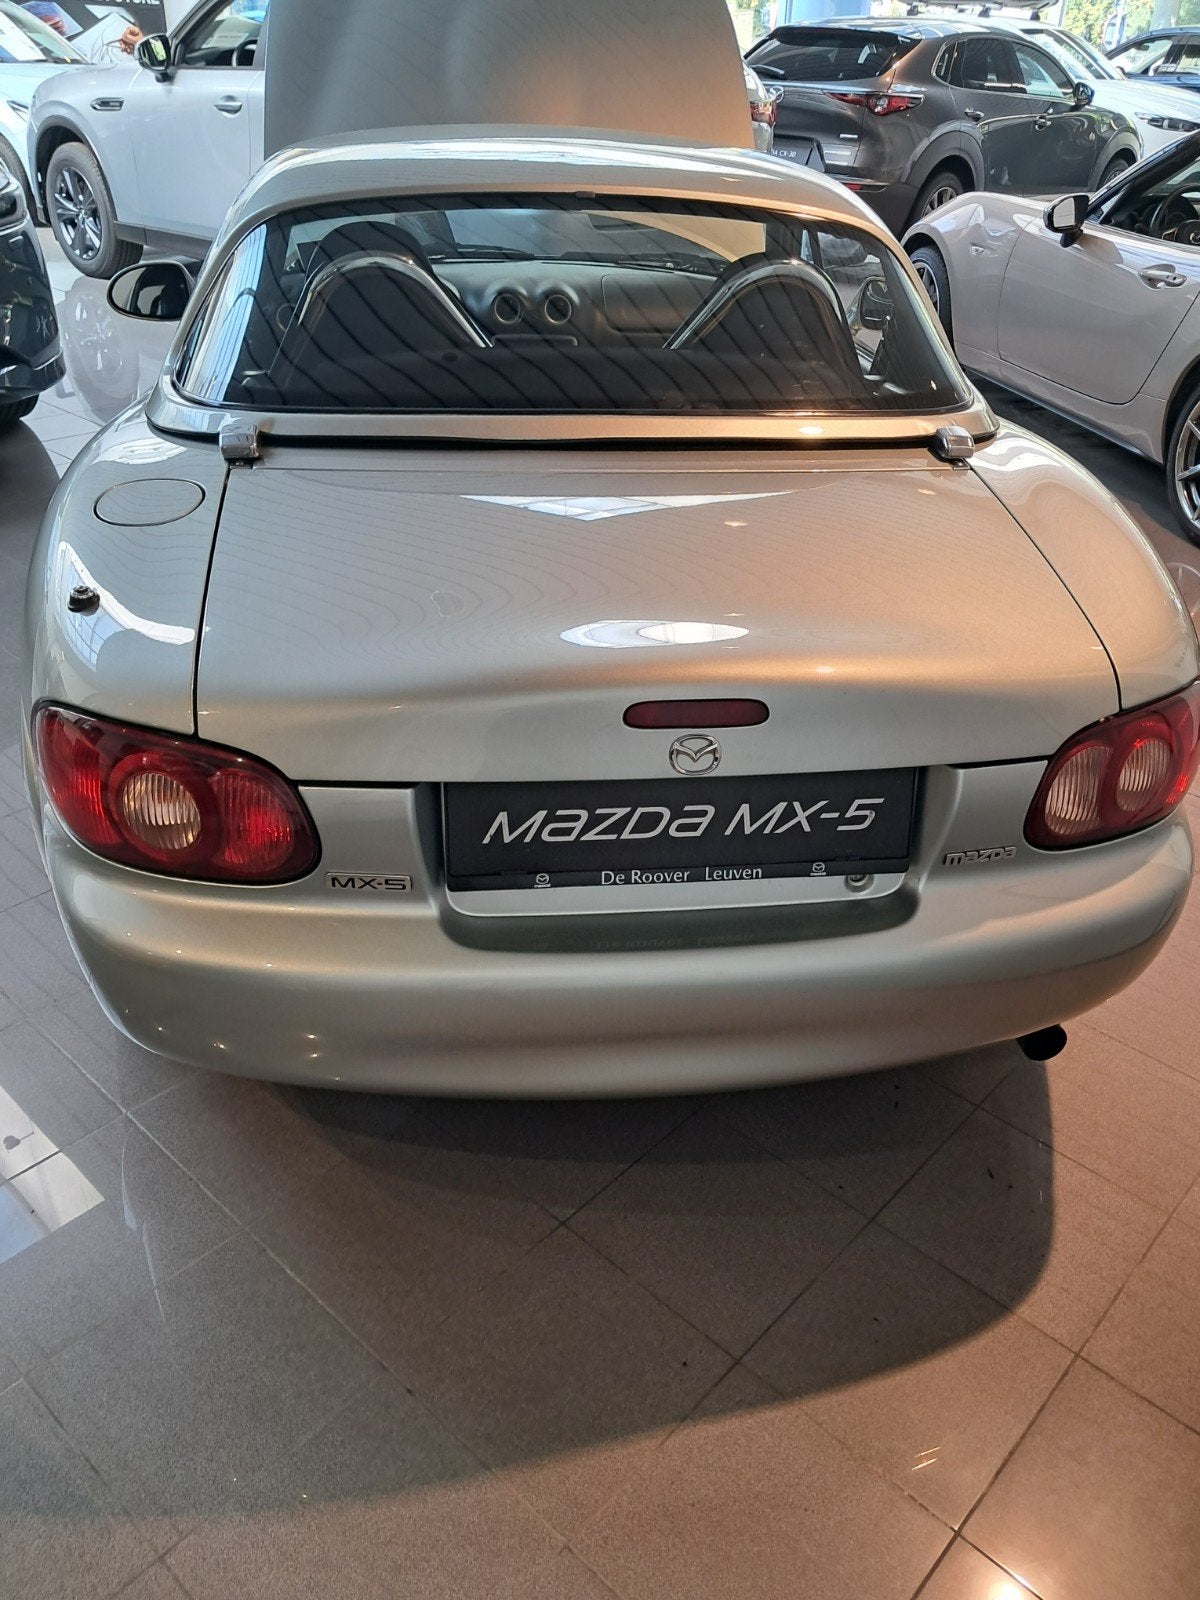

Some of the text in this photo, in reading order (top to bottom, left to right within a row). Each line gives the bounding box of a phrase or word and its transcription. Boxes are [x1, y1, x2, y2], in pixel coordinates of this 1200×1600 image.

[724, 798, 885, 836] MX-5
[331, 876, 407, 890] MX-5
[601, 866, 762, 885] De Roover Leuven
